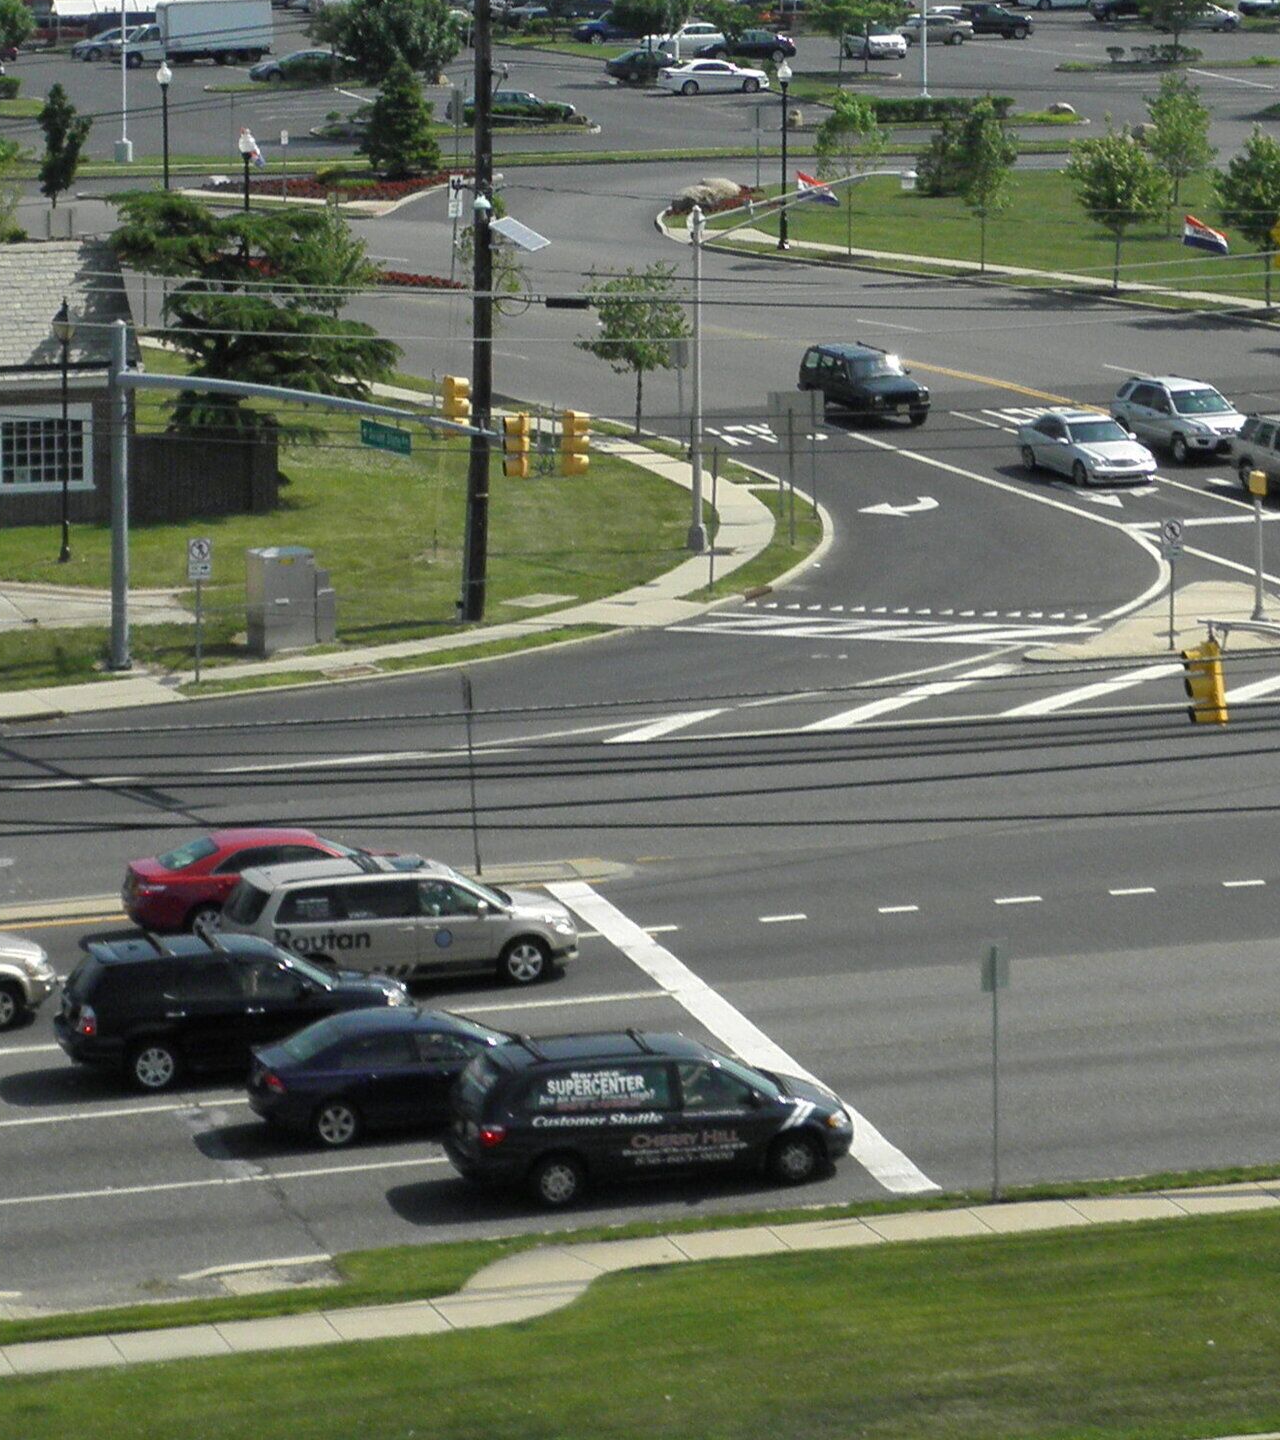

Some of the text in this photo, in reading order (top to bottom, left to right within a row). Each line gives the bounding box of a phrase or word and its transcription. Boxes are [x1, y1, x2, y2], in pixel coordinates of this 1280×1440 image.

[274, 928, 371, 951] Routan
[547, 1075, 645, 1096] SUPERCENTER
[532, 1112, 663, 1128] Customer Shuttle
[630, 1130, 739, 1148] CHERRY HILL
